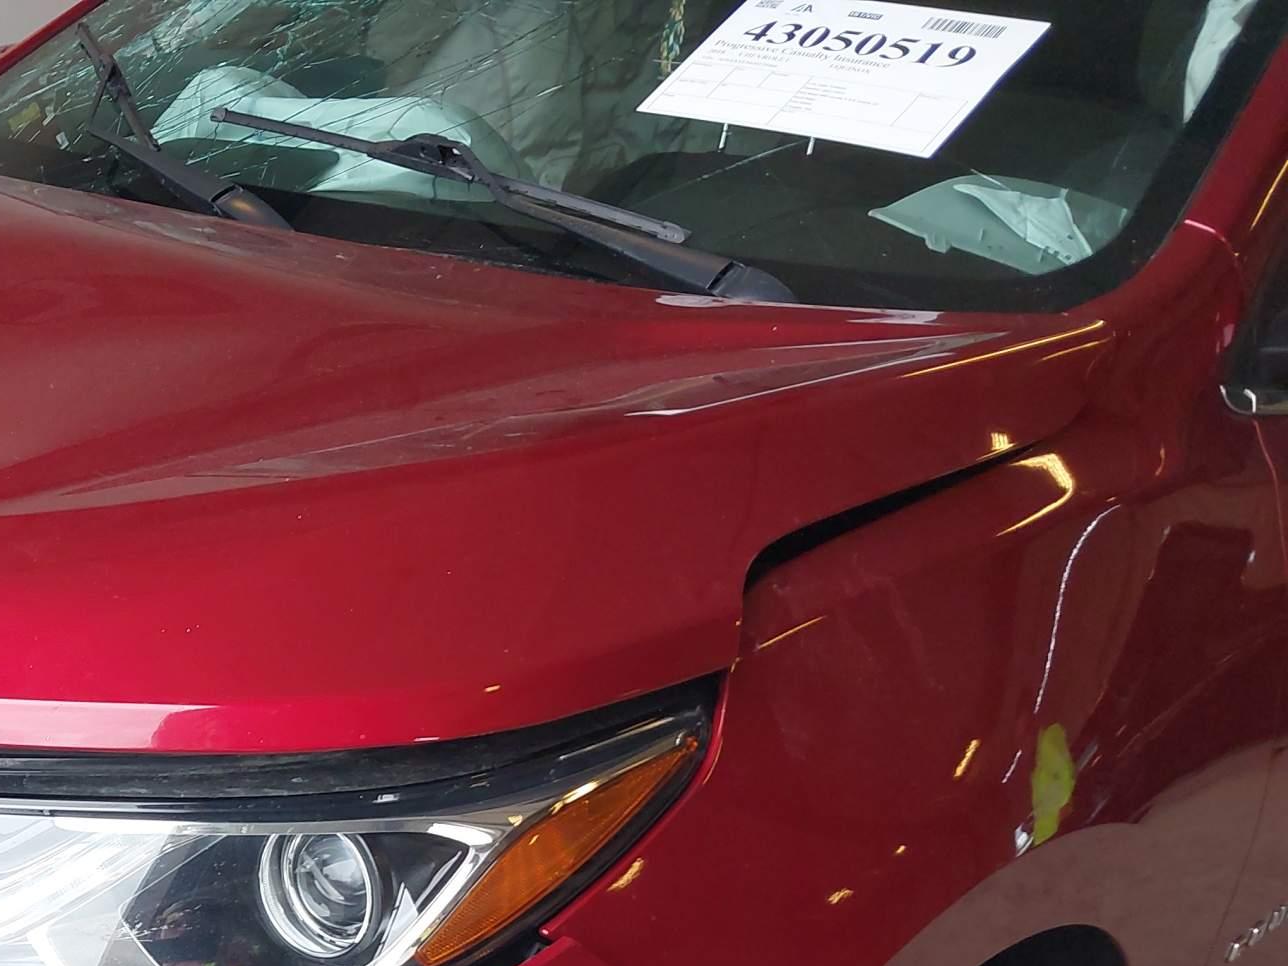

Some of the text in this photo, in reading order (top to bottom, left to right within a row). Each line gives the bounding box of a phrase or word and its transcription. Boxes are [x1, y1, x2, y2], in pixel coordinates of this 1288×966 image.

[714, 40, 779, 53] Progressive
[781, 47, 829, 60] Casualty
[833, 54, 891, 69] Insurance
[744, 20, 977, 67] 43050519
